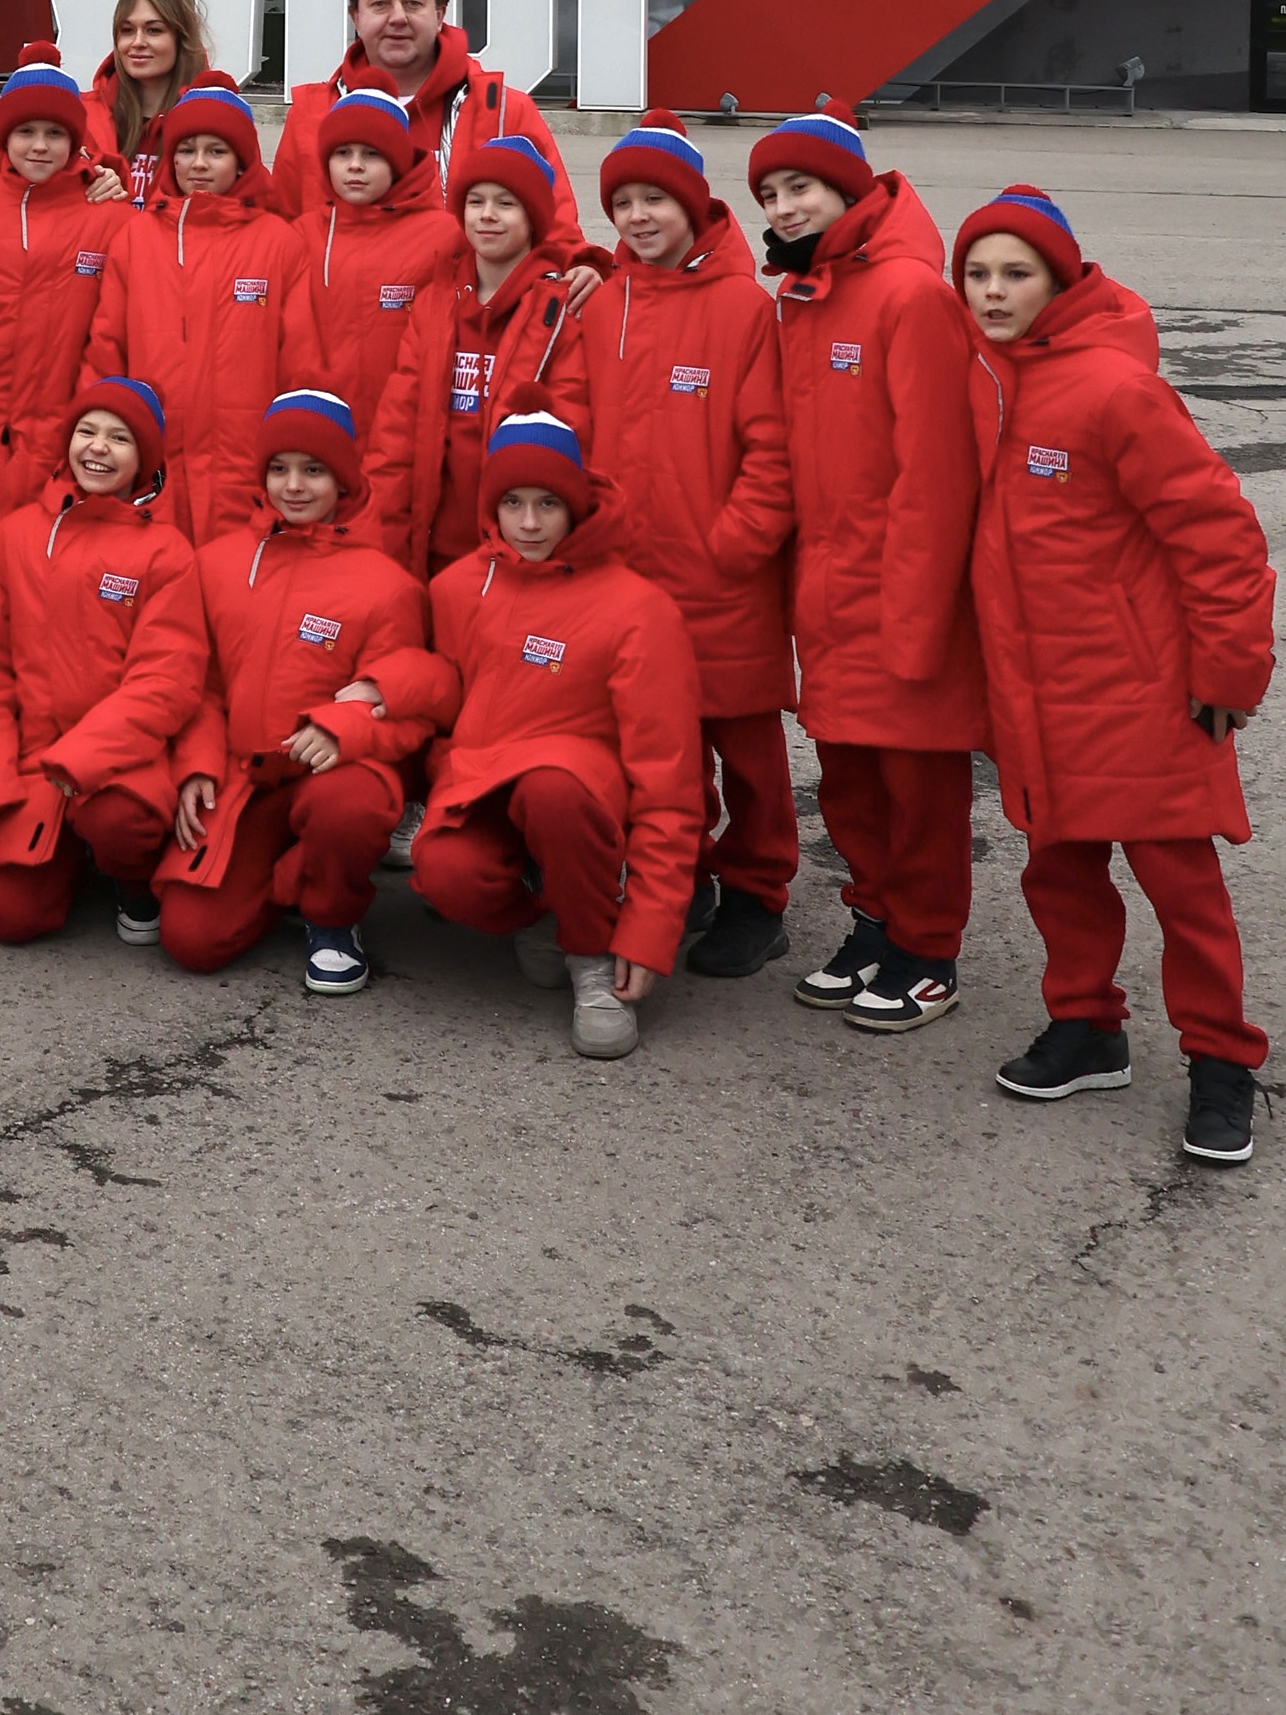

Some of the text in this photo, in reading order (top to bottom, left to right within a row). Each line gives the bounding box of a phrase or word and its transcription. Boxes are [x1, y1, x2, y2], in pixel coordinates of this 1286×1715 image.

[672, 372, 707, 385] МАШИНА
[1029, 454, 1065, 469] МАШИНА
[101, 580, 135, 595] МАШИНА
[301, 621, 336, 638] МАШИНА
[524, 642, 560, 659] МАШИНА
